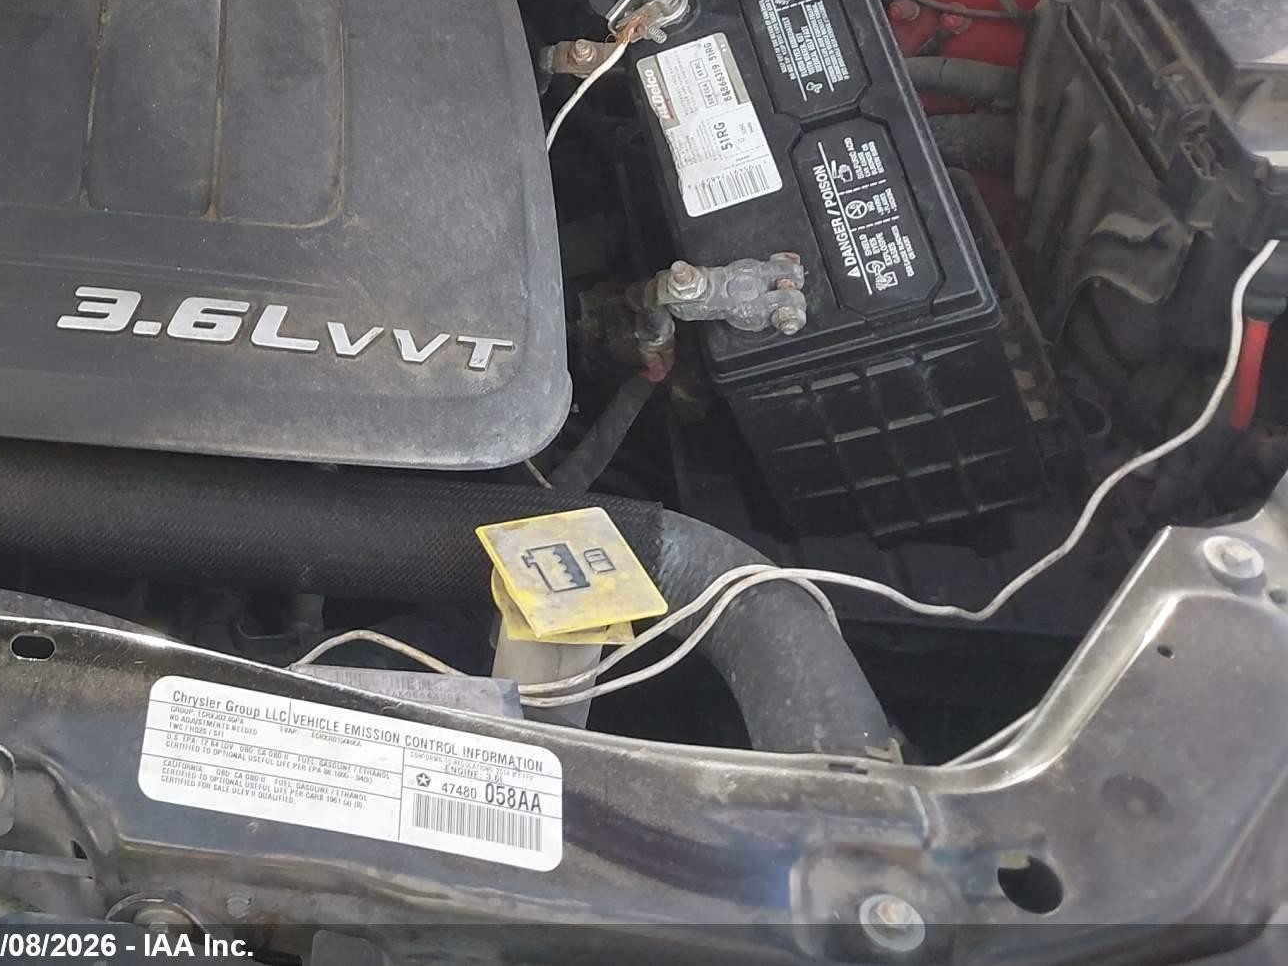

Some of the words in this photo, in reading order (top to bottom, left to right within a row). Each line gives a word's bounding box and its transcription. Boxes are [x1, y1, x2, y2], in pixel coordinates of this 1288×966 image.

[712, 120, 733, 151] 51RG
[811, 163, 837, 208] POISON
[829, 216, 857, 266] DANGER
[56, 285, 320, 353] 3.6L
[326, 320, 513, 372] VVT
[171, 689, 222, 711] Chrysler
[224, 699, 261, 719] Group
[264, 707, 287, 722] LLC
[292, 712, 340, 732] VEHICLE
[343, 722, 400, 744] EMISSION
[404, 734, 458, 755] CONTROL
[462, 745, 543, 772] INFORMATION
[441, 781, 477, 799] 47480
[484, 782, 542, 814] 058AA
